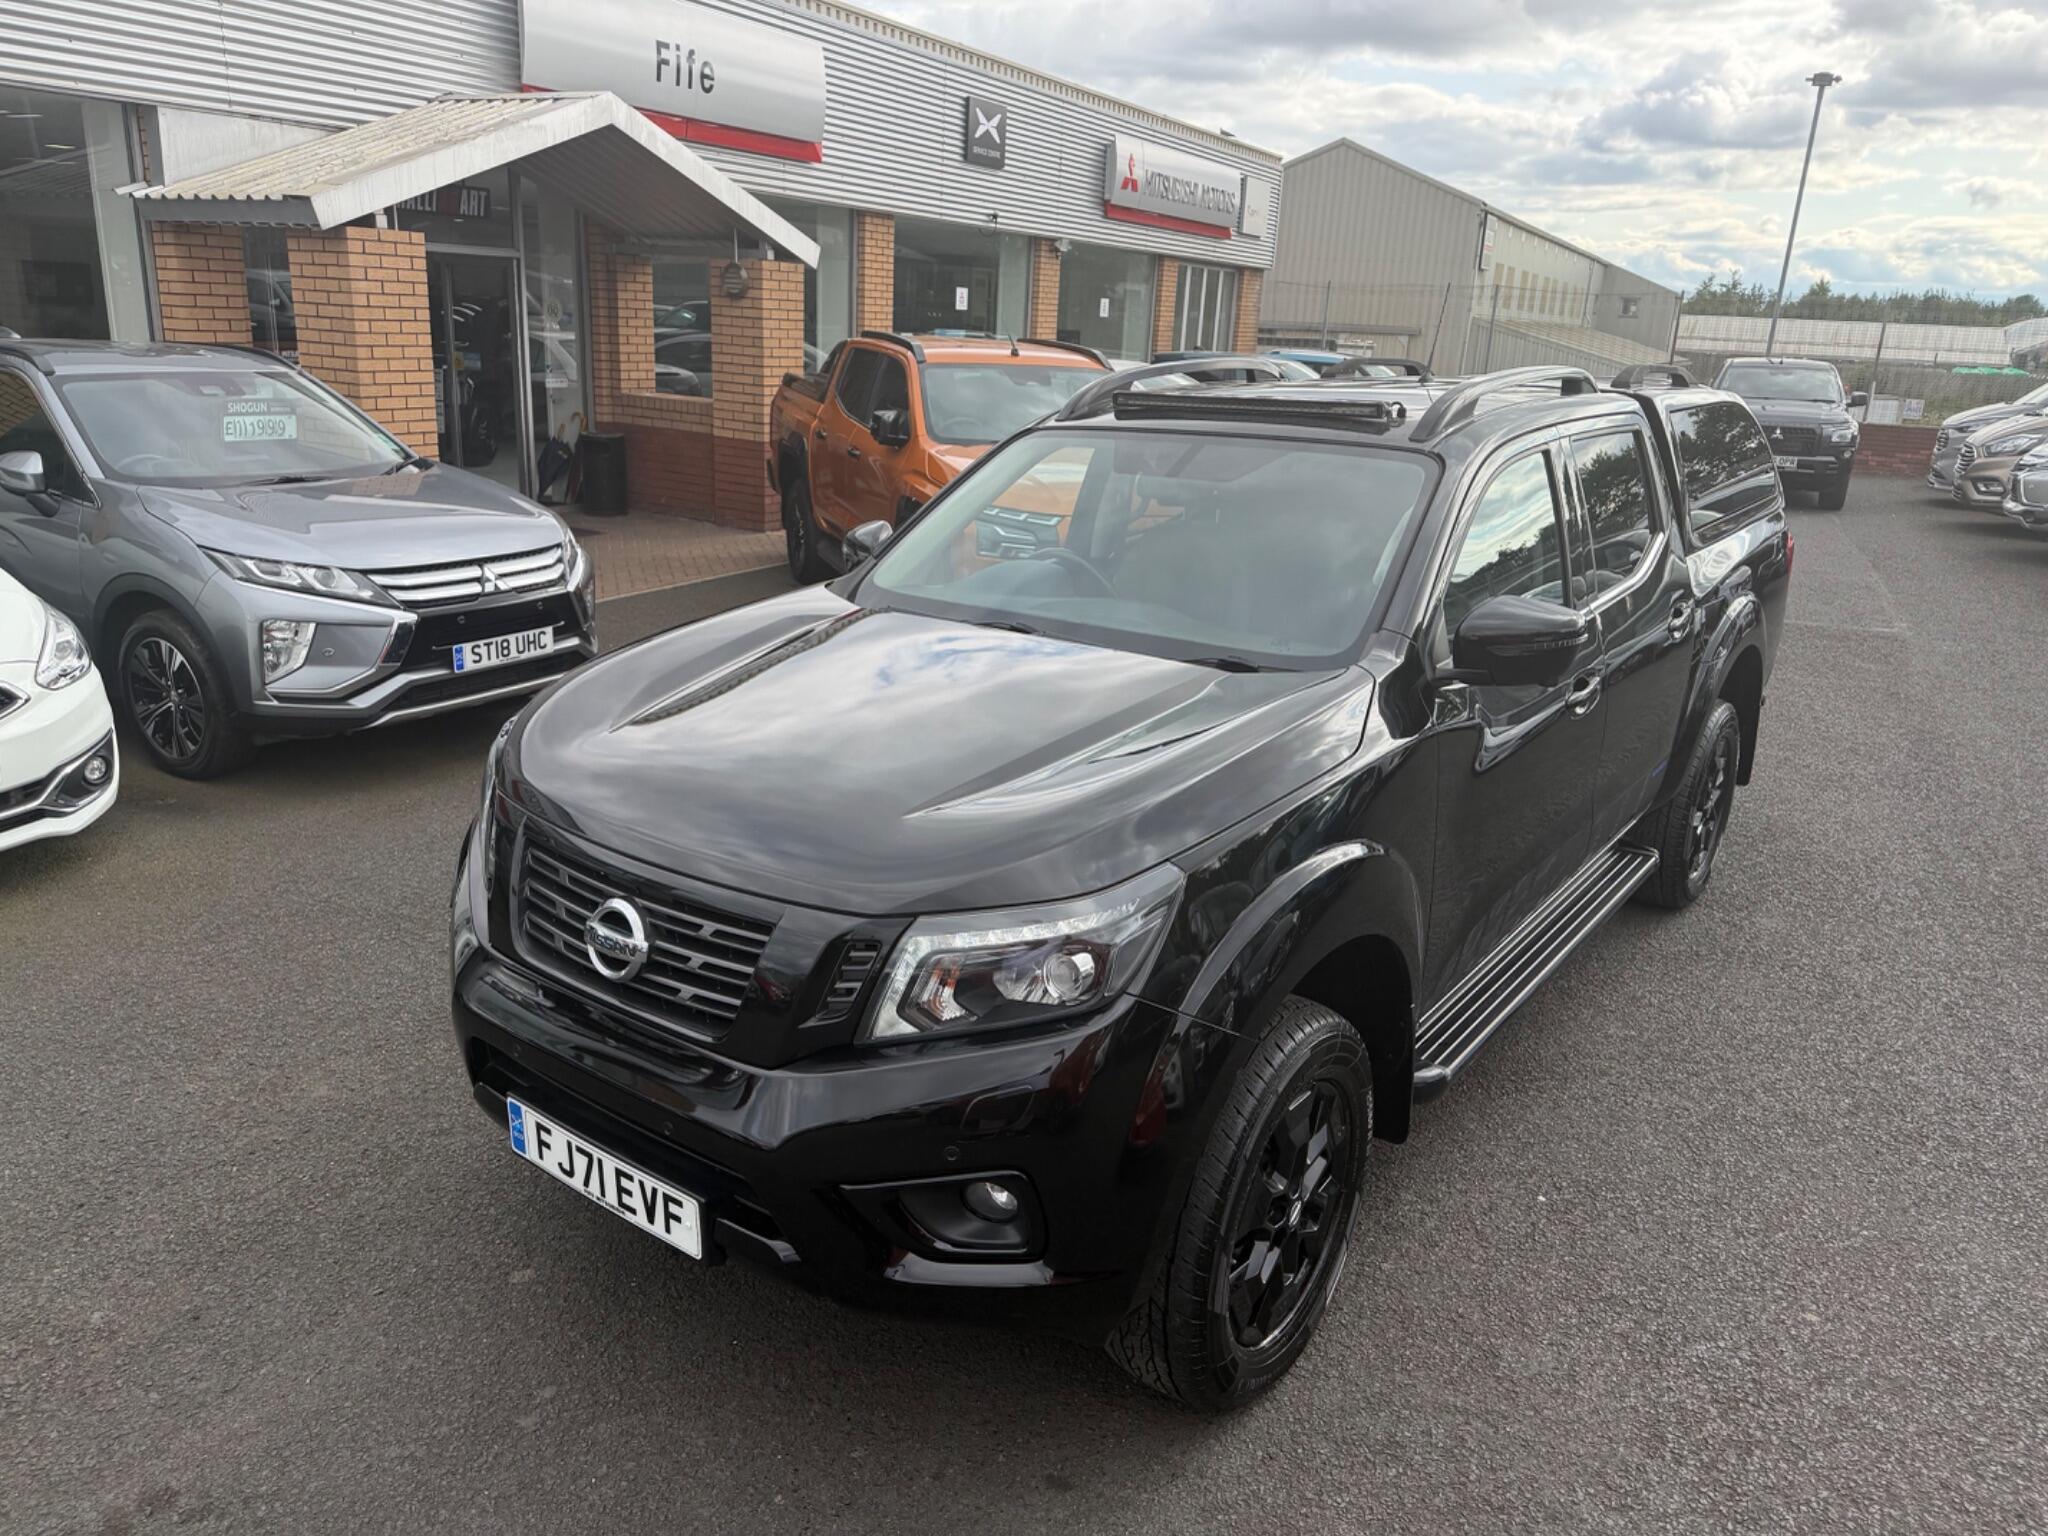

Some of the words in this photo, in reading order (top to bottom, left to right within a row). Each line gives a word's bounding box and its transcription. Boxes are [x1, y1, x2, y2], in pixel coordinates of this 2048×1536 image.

[656, 40, 715, 94] Fife
[460, 188, 487, 216] ART
[227, 401, 268, 413] SHOGUN
[471, 638, 512, 664] ST18
[515, 630, 548, 654] UHC
